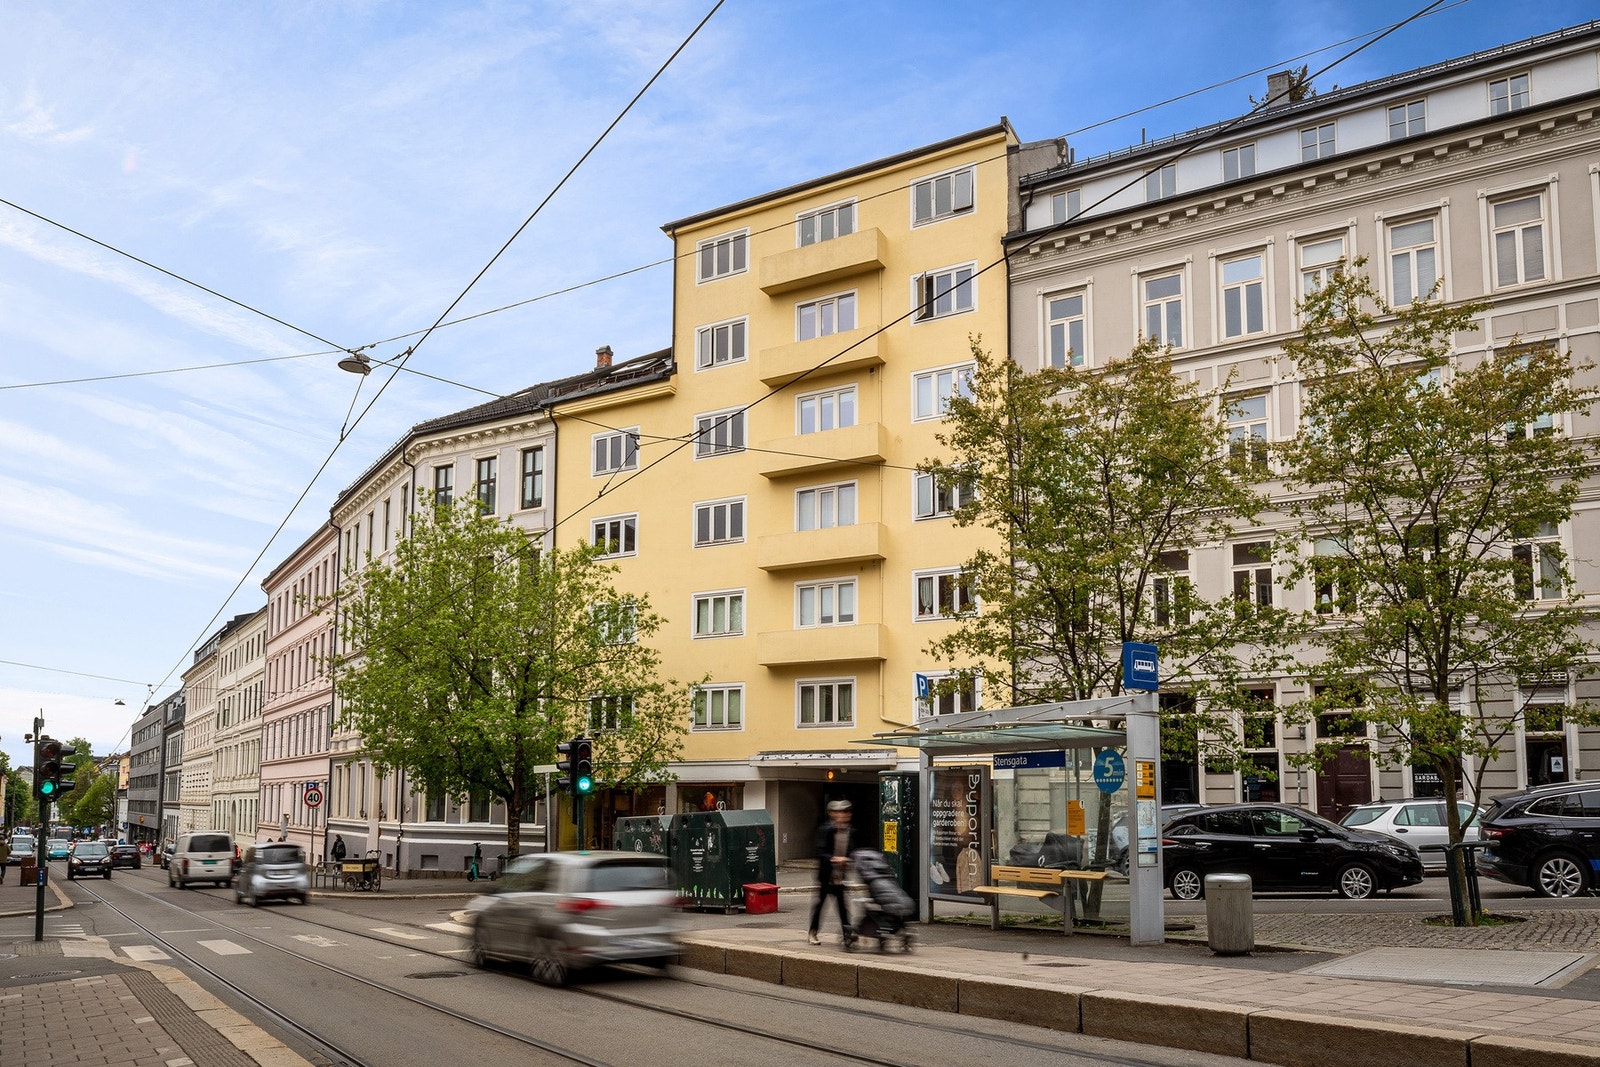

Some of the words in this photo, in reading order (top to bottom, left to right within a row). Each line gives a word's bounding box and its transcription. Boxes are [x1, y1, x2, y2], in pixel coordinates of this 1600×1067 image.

[919, 677, 926, 695] P
[994, 756, 1027, 768] Stensgata
[1104, 757, 1114, 777] 5
[307, 793, 319, 802] 40
[932, 799, 943, 808] Når
[943, 799, 950, 808] du
[951, 800, 963, 808] skal
[932, 809, 965, 819] oppgradere
[932, 819, 965, 828] garderoben
[966, 774, 980, 876] Byporten
